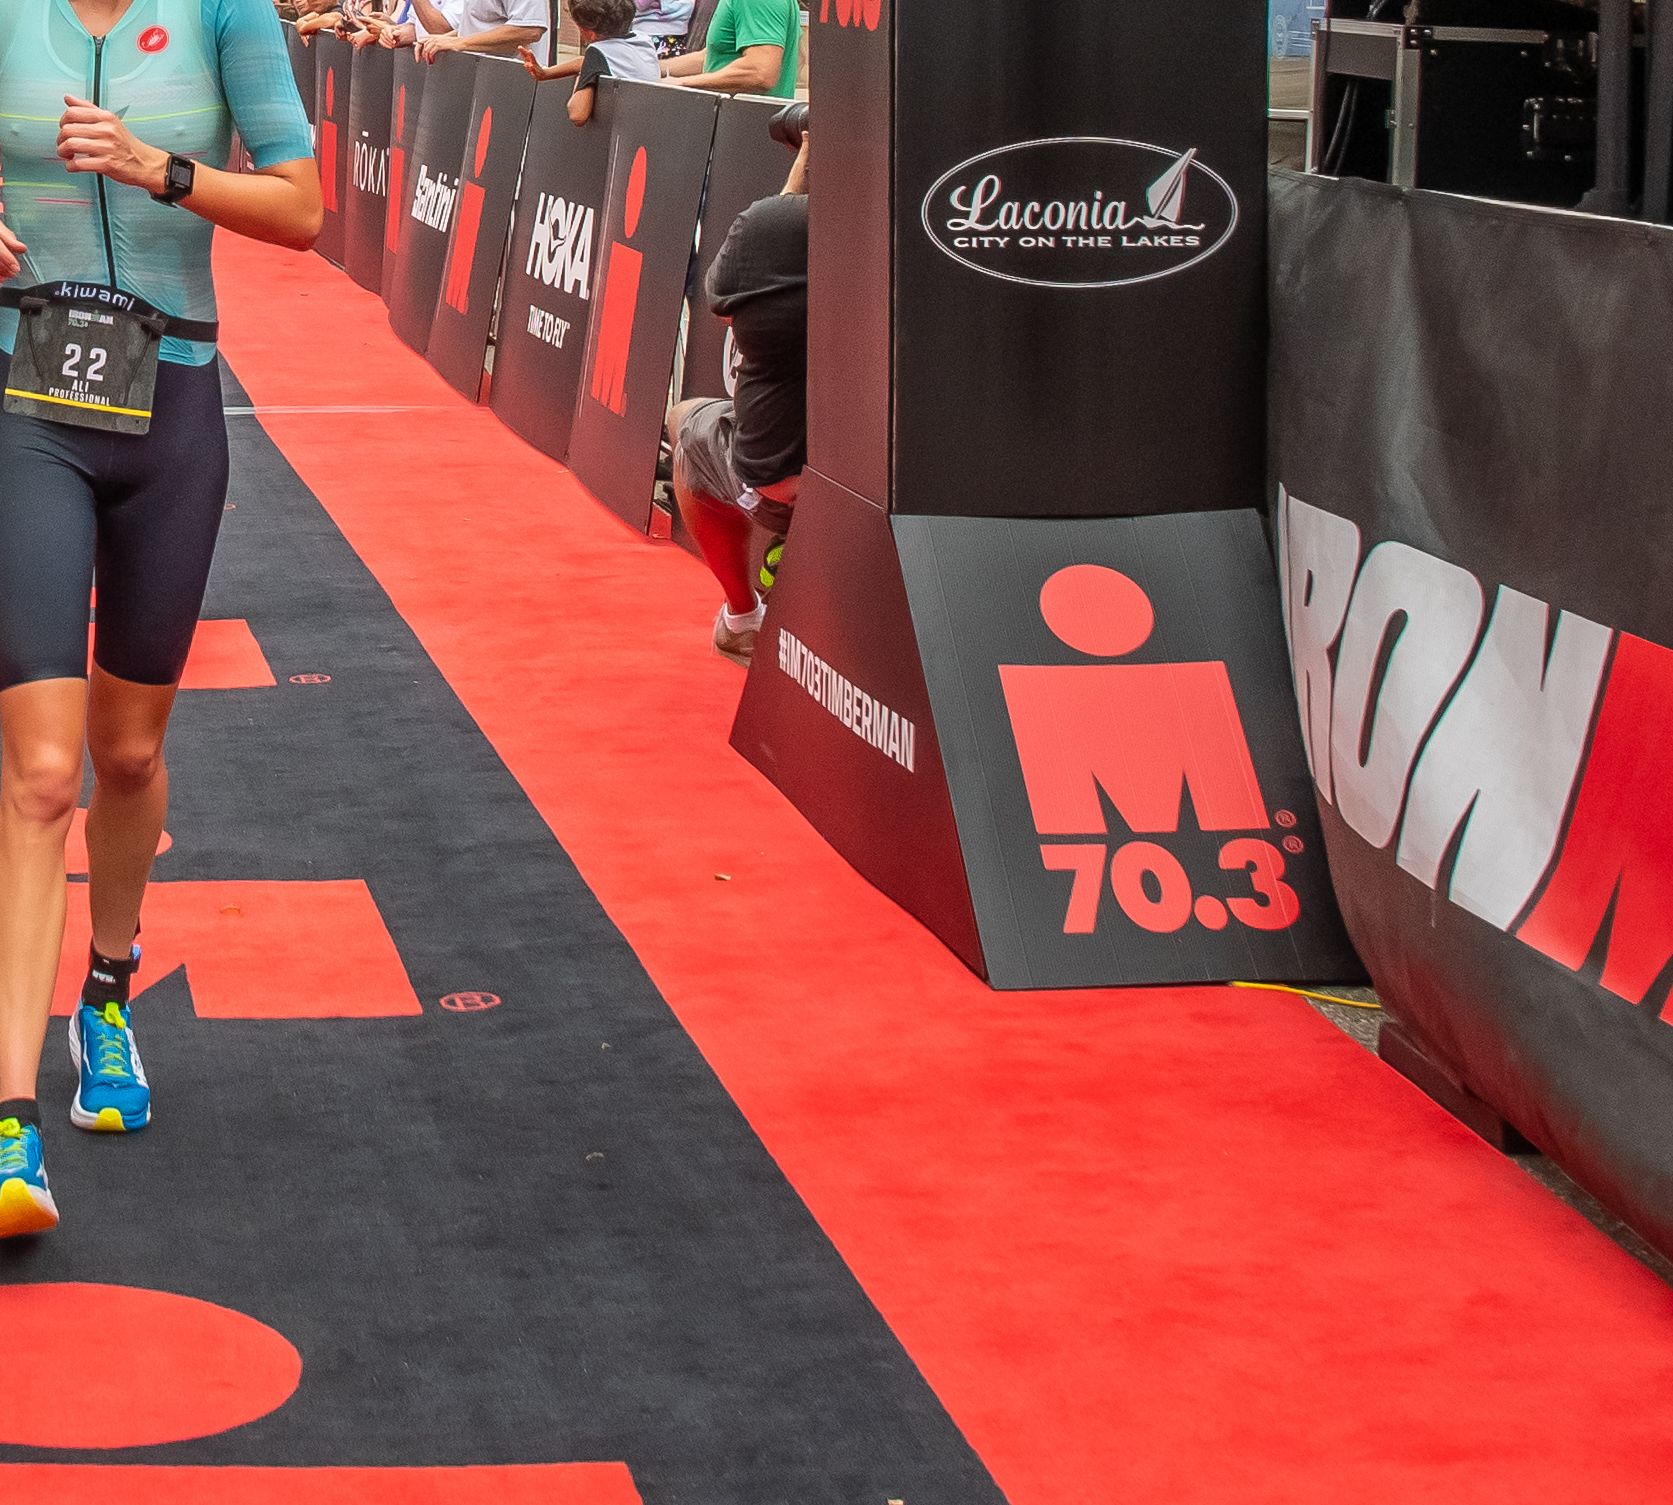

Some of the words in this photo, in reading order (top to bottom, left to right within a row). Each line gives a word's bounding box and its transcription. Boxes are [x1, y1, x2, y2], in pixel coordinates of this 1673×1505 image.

[946, 174, 1130, 231] Laconia
[526, 192, 594, 300] HOKA
[953, 236, 1010, 248] CITY
[1018, 236, 1055, 248] ON
[1062, 236, 1111, 248] THE
[1121, 235, 1201, 248] LAKES
[60, 281, 135, 311] kiwami
[527, 304, 545, 339] TIME
[62, 343, 108, 382] 22
[49, 387, 111, 406] PROFESSIONAL
[71, 379, 89, 393] ALI
[778, 627, 916, 774] #IM703TIMBERMAN
[1039, 838, 1301, 934] 70.3
